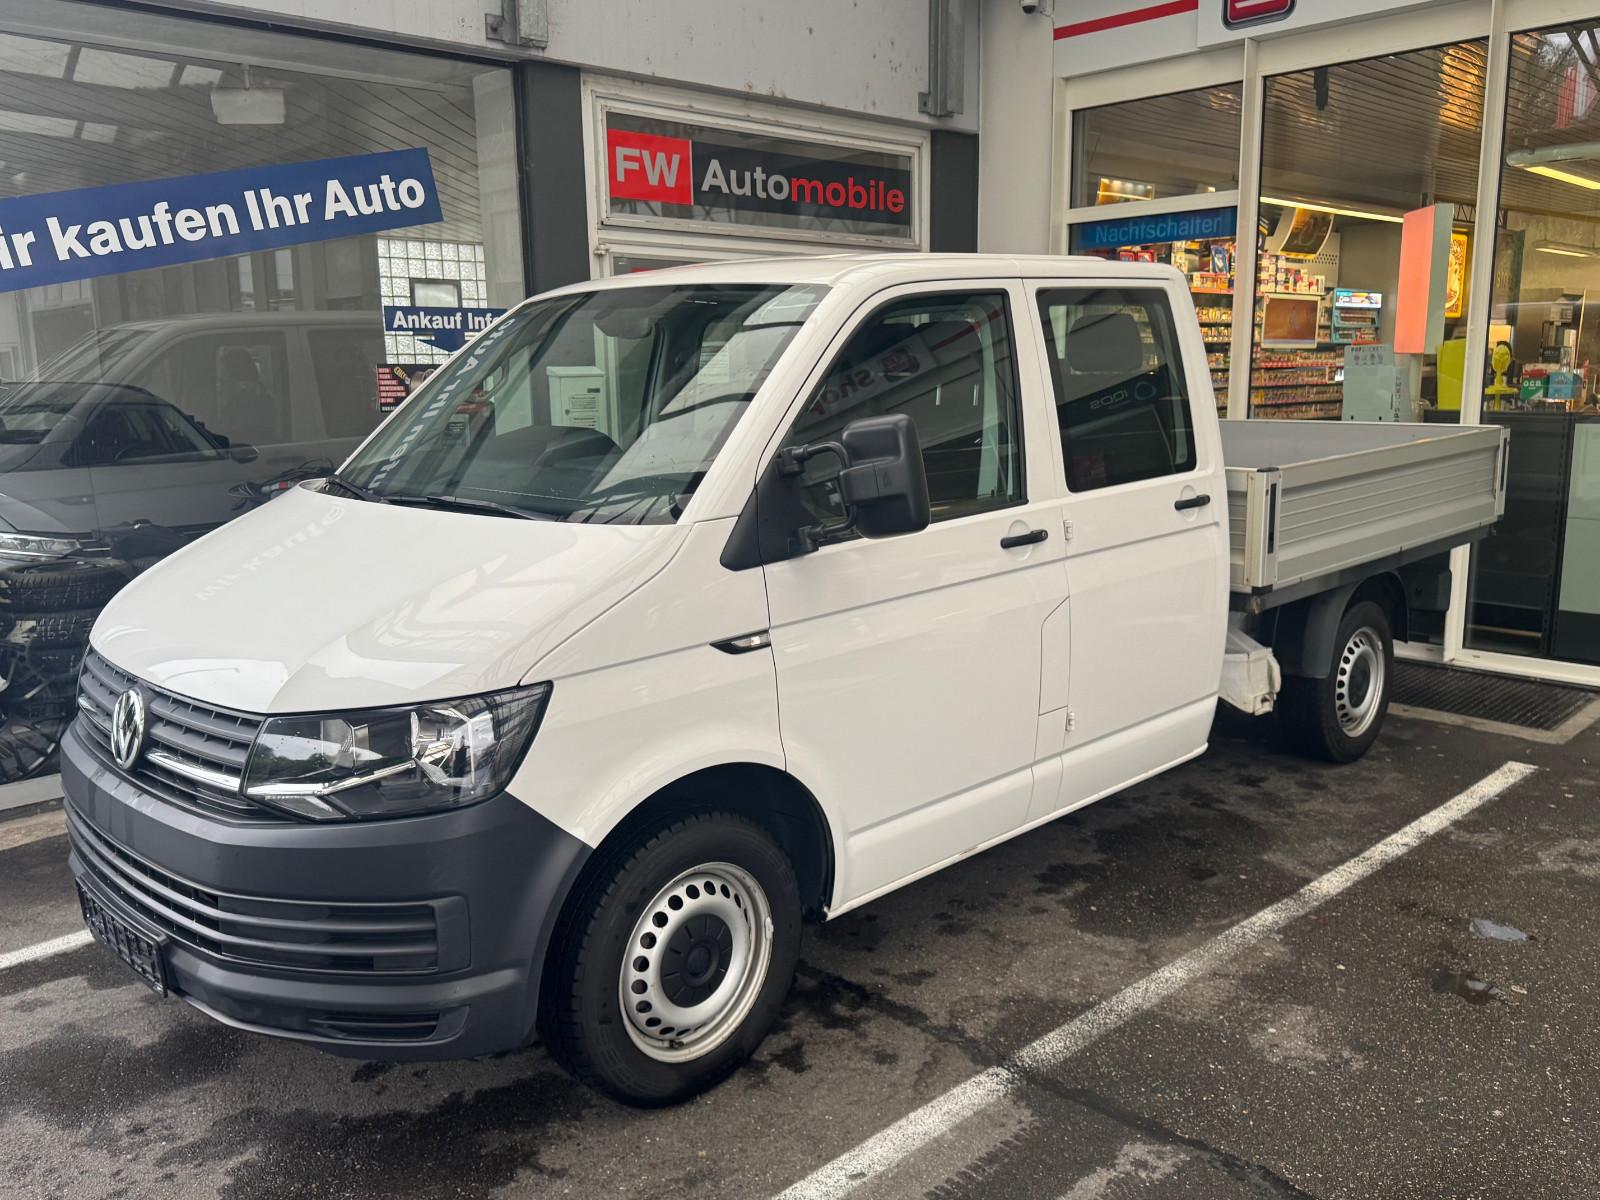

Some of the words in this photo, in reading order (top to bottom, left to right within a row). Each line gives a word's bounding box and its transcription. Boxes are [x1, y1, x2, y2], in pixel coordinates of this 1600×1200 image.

[615, 147, 681, 188] FW
[701, 158, 905, 213] Automobile
[0, 225, 36, 270] ir
[47, 201, 240, 261] kaufen
[244, 189, 313, 231] Ihr
[324, 174, 426, 220] Auto
[1095, 216, 1221, 244] Nachtschalter
[393, 310, 463, 330] Ankauf
[1523, 379, 1542, 387] OCB
